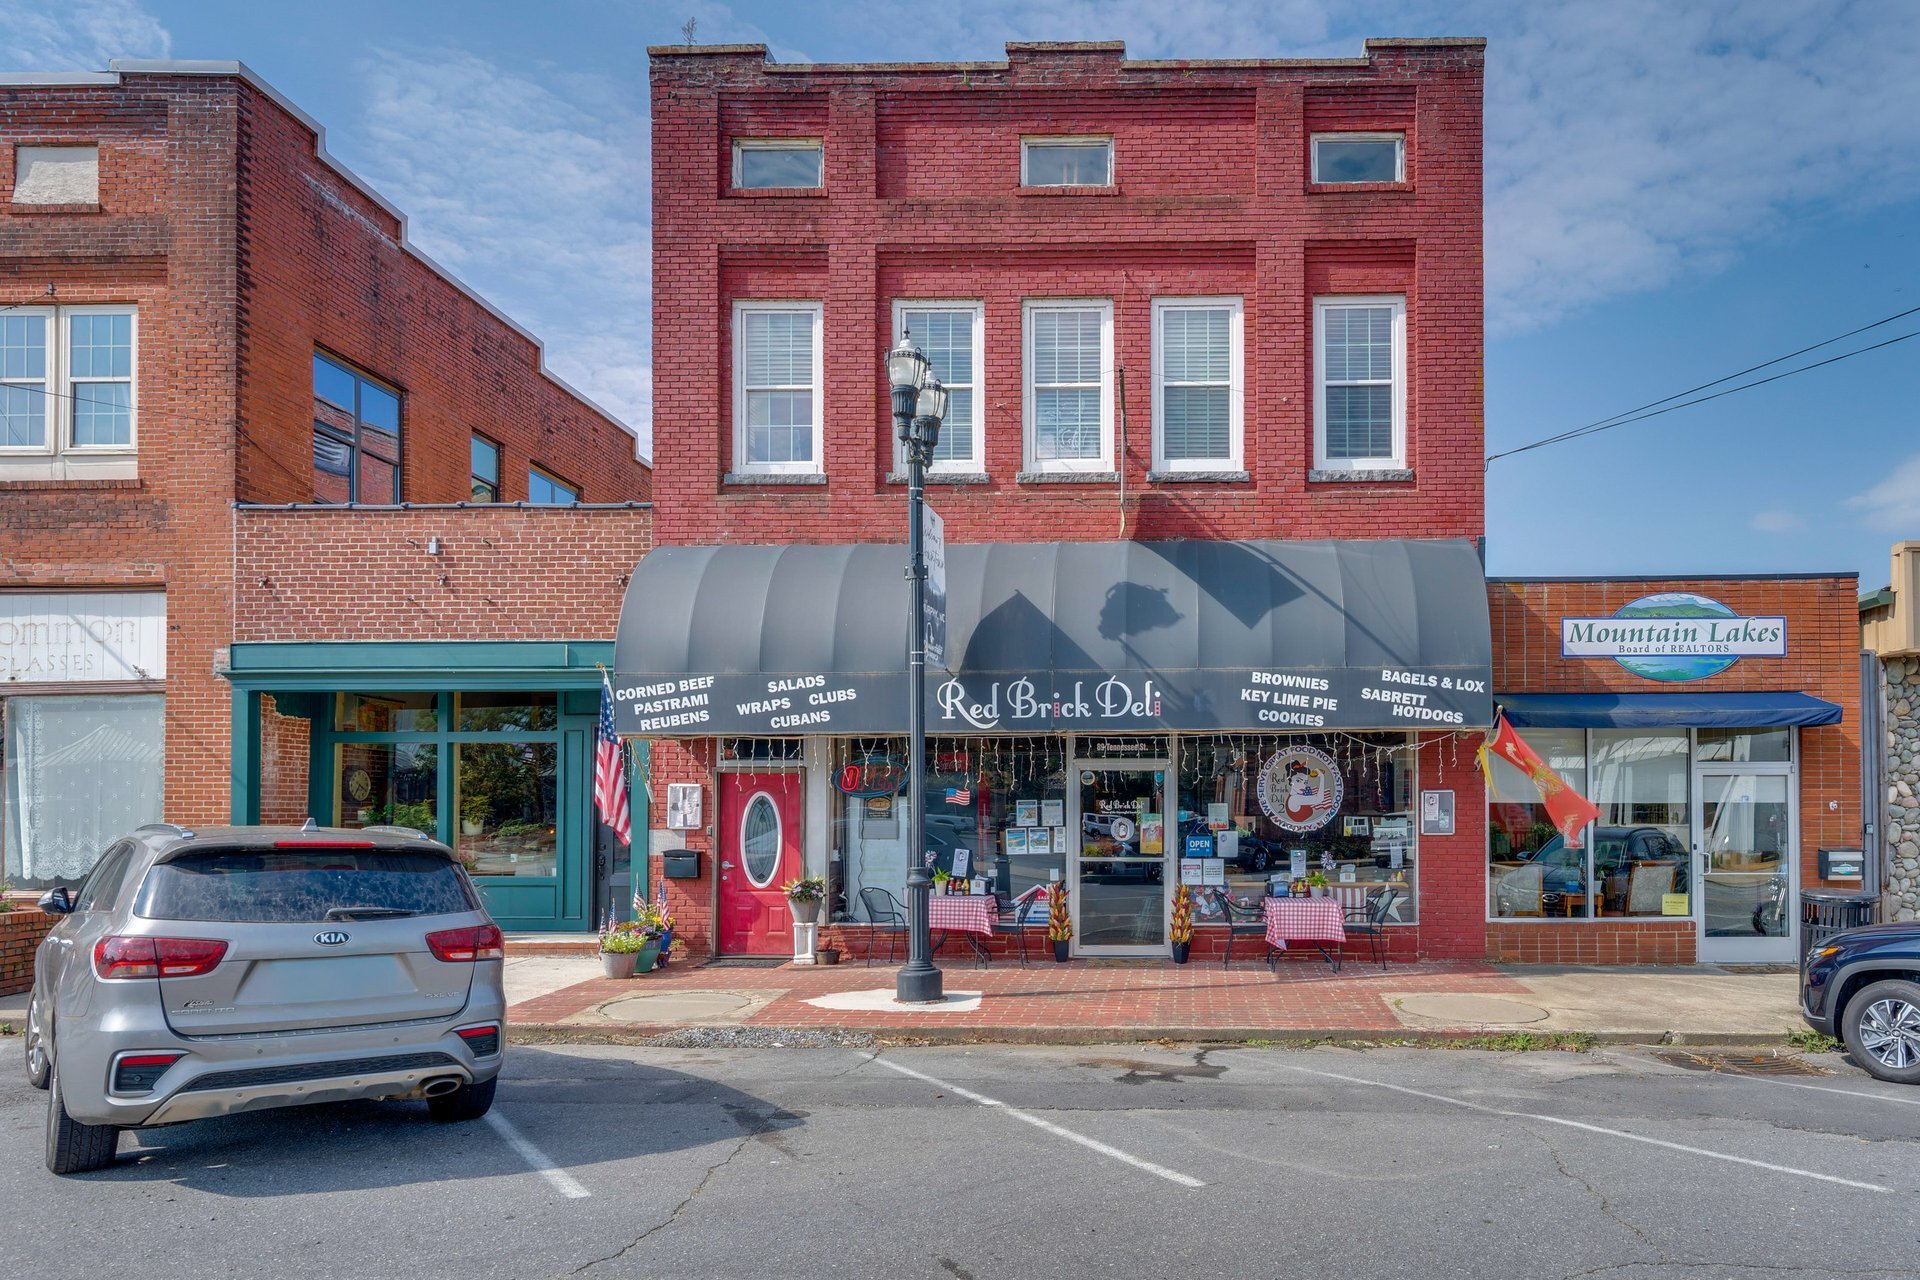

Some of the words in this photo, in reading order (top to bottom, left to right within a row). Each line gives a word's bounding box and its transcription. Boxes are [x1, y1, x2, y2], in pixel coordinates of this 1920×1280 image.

[1567, 621, 1699, 644] Mountain
[1708, 617, 1780, 644] Lakes
[1618, 644, 1650, 653] Board
[1655, 644, 1666, 653] of
[1670, 644, 1730, 653] REALTORS
[616, 682, 676, 701] CORNED
[679, 676, 714, 692] BEEF
[767, 675, 826, 693] SALADS
[1251, 671, 1329, 691] BROWNIES
[1381, 669, 1438, 688] BAGELS
[1440, 677, 1453, 690] &
[1456, 679, 1485, 693] LOX
[634, 693, 709, 715] PASTRAMI
[736, 697, 791, 716] WRAPS
[808, 688, 857, 706] CLUBS
[937, 677, 1000, 729] Red
[1006, 676, 1091, 719] Brick
[1095, 675, 1161, 717] Deli
[1241, 688, 1271, 703] KEY
[1273, 692, 1310, 708] LIME
[1313, 696, 1338, 711] PIE
[1361, 687, 1427, 706] SABRETT
[640, 710, 710, 731] REUBENS
[770, 710, 831, 729] CUBANS
[1258, 709, 1325, 727] COOKIES
[1392, 704, 1464, 724] HOTDOGS
[1096, 743, 1104, 751] 89
[1106, 743, 1139, 751] Tennessee
[1140, 743, 1149, 751] St.
[1290, 746, 1316, 755] FOOD
[1265, 748, 1288, 771] GREAT
[1316, 750, 1335, 767] NOT
[1258, 771, 1268, 799] SERVE
[1271, 772, 1286, 784] Red
[1331, 766, 1342, 788] FAST
[1271, 784, 1288, 793] Brick
[1099, 799, 1113, 811] Red
[1113, 799, 1131, 809] Brick
[1130, 799, 1144, 809] Deli
[1260, 800, 1272, 815] WE
[1271, 794, 1285, 804] Deli
[1278, 804, 1285, 813] 2
[1329, 789, 1342, 816] FOOD
[1189, 840, 1210, 848] OPEN
[320, 933, 346, 943] KIA
